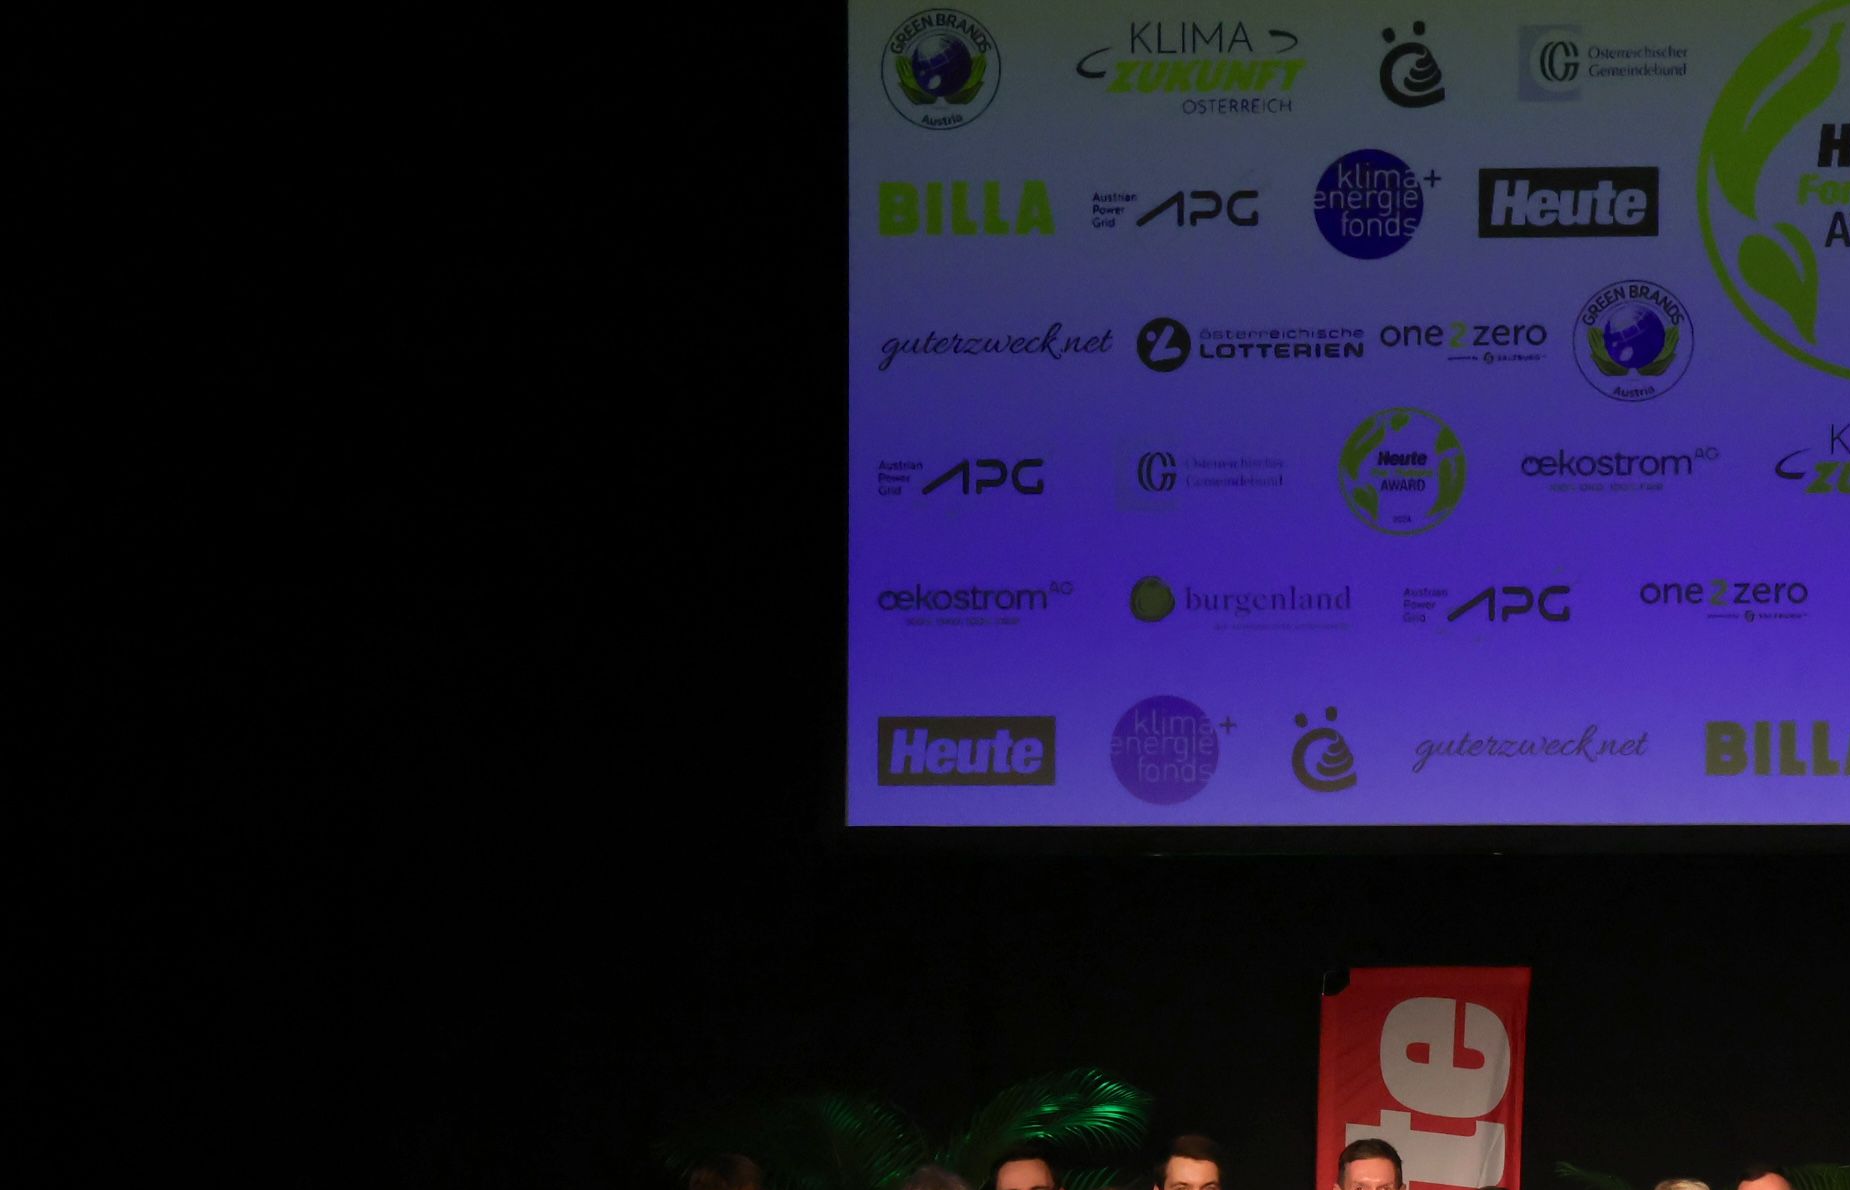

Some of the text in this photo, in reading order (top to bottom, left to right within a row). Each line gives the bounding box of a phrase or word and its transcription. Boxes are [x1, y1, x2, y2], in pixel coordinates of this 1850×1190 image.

[891, 12, 992, 54] GREEN BRANDS
[1130, 21, 1253, 54] KLIMA
[1106, 60, 1306, 93] ZUKUNFT
[920, 112, 964, 128] Austria
[1337, 162, 1417, 188] klima
[878, 180, 1055, 236] BILLA
[1136, 190, 1259, 226] APG
[1313, 190, 1419, 217] energie
[1490, 179, 1648, 226] Heute
[1341, 213, 1417, 238] fonds
[1582, 284, 1685, 326] GREEN BRANDS
[878, 321, 1114, 372] guterzweck.net
[1199, 326, 1365, 340] österreichische
[1199, 342, 1365, 359] LOTTERIEN
[1612, 384, 1656, 398] Austria
[1377, 450, 1428, 468] Heute
[921, 458, 1045, 495] APG
[1379, 478, 1426, 492] AWARD
[1185, 585, 1353, 616] burgenland
[1447, 586, 1571, 622] APG
[1133, 708, 1214, 735] klima
[889, 727, 1044, 776] Heute
[1109, 735, 1214, 765] energie
[1411, 723, 1649, 774] guterzweck.net
[1137, 755, 1214, 784] fonds
